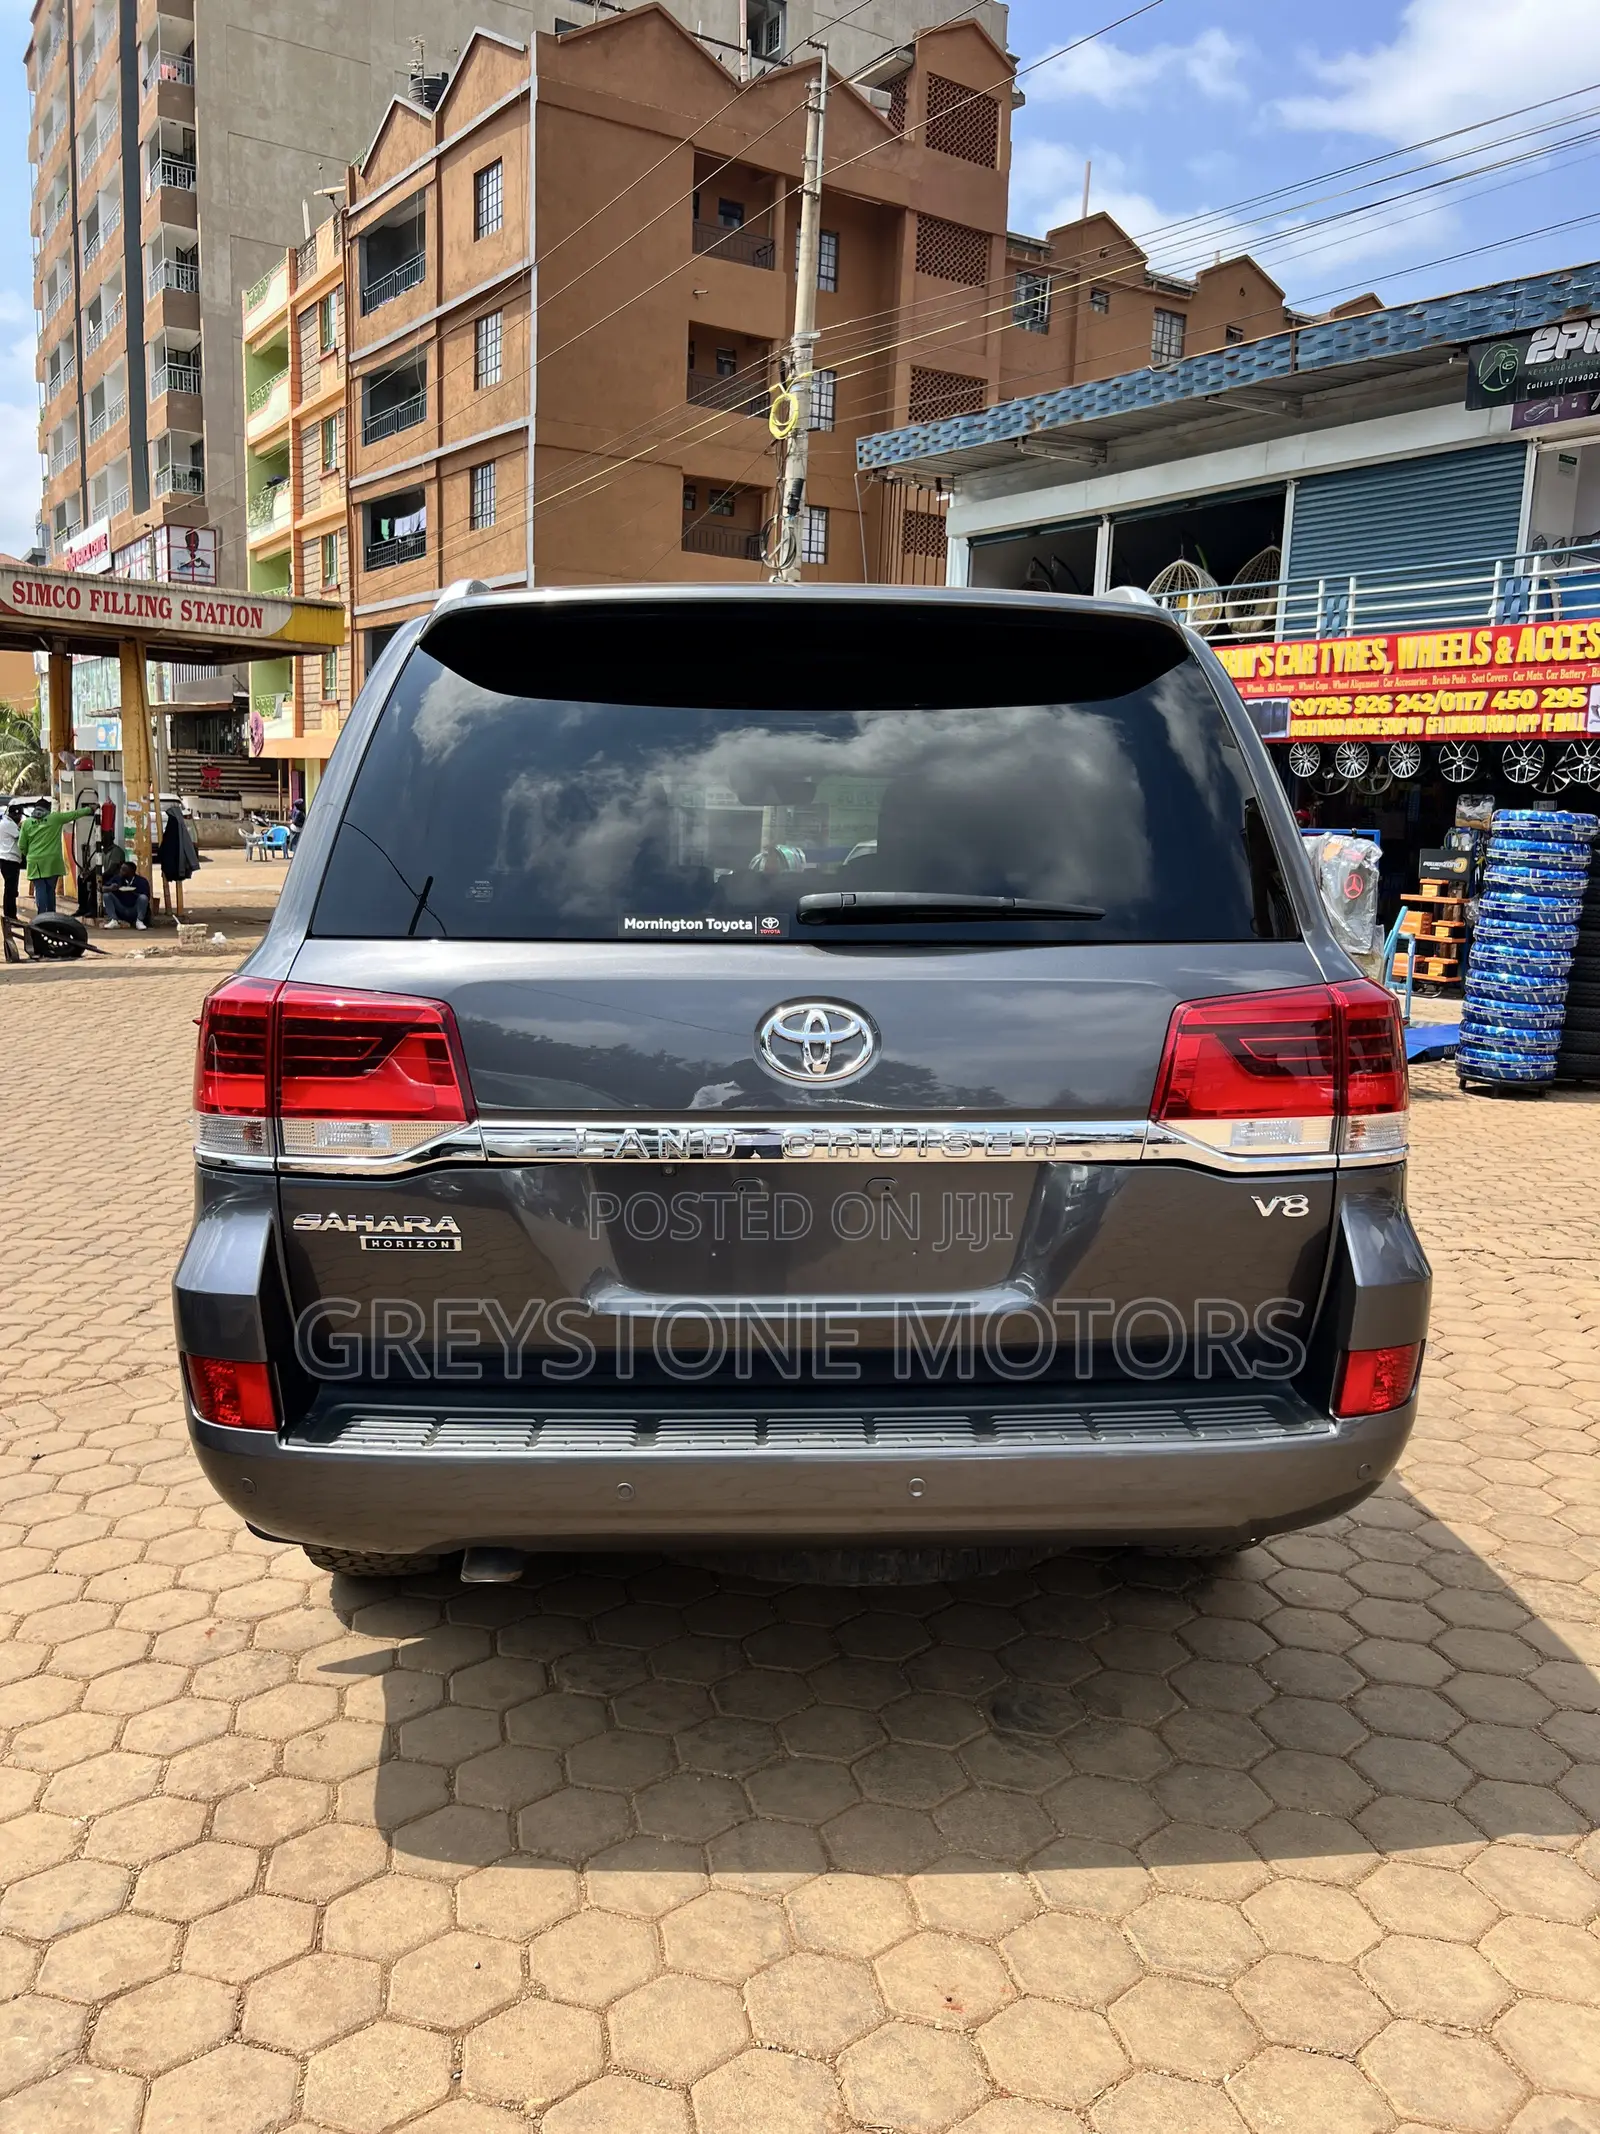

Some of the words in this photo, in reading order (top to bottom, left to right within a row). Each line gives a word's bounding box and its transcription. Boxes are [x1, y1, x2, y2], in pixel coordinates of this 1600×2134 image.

[1527, 381, 1542, 390] Call
[1558, 372, 1600, 385] 07019002
[12, 580, 81, 610] SIMCO
[89, 589, 172, 619] FILLING
[180, 599, 263, 629] STATION
[1214, 645, 1274, 678] BIN'S
[1275, 643, 1318, 676] CAR
[1320, 638, 1394, 674] TYRES,
[1397, 630, 1492, 669] WHEELS
[1495, 636, 1514, 664] &
[1515, 622, 1600, 663] ACCES
[1383, 678, 1394, 688] Car
[1395, 676, 1428, 688] Accessories
[1432, 674, 1450, 685] Brake
[1451, 673, 1466, 684] Pads
[1471, 673, 1485, 684] Seat
[1486, 672, 1507, 683] Covers
[1513, 671, 1525, 681] Car
[1546, 669, 1558, 680] Car
[1559, 668, 1586, 681] Battery
[1301, 697, 1352, 716] 0795
[1353, 695, 1393, 714] 926
[1394, 690, 1488, 715] 242/0117
[1491, 688, 1538, 710] 450
[1540, 687, 1588, 709] 295
[1486, 713, 1516, 733] ROAD
[1516, 712, 1540, 733] OPP
[1541, 712, 1587, 732] K-MALL
[624, 917, 703, 932] Mornington
[705, 917, 753, 932] Toyota
[575, 1128, 736, 1159] LAND
[782, 1127, 1058, 1158] CRUISER
[1250, 1194, 1309, 1218] V8
[293, 1212, 462, 1233] SAHARA
[371, 1239, 450, 1248] HORIZON
